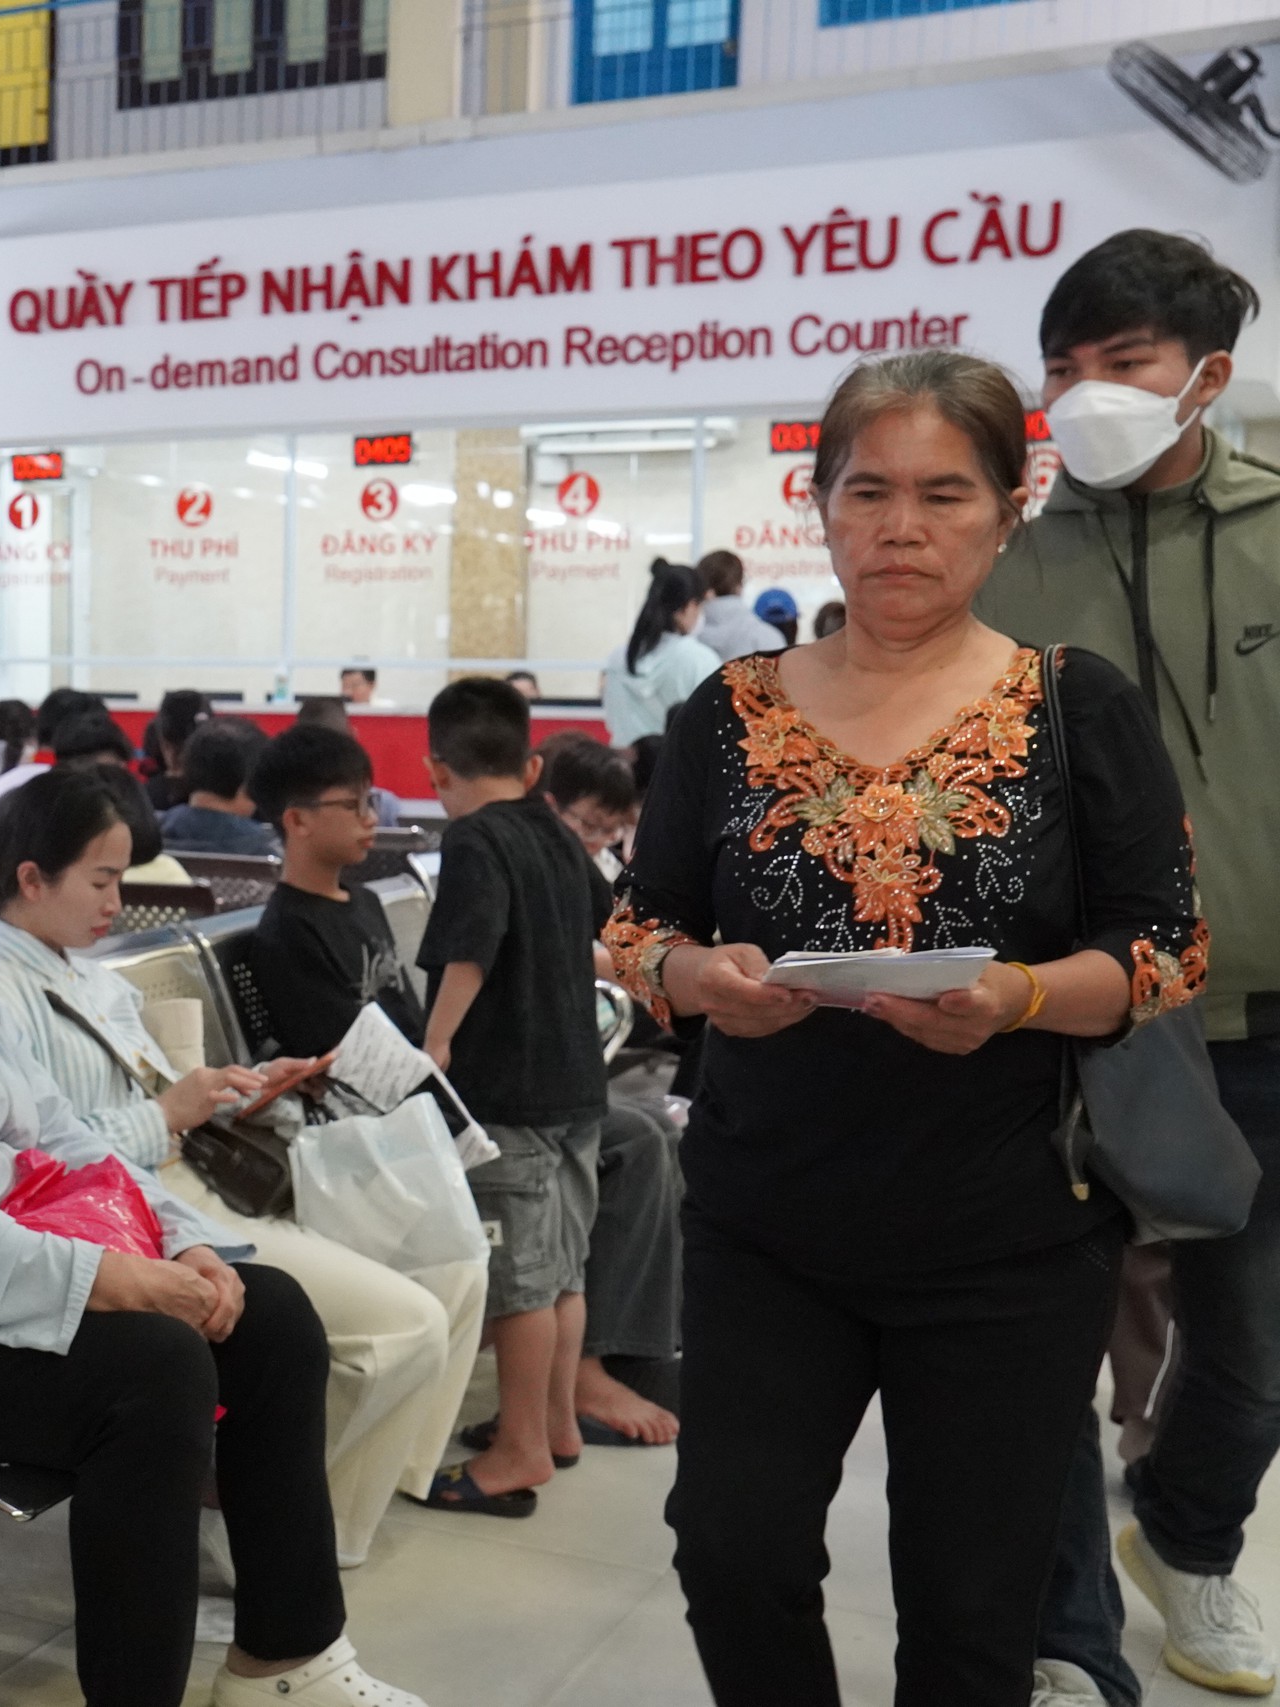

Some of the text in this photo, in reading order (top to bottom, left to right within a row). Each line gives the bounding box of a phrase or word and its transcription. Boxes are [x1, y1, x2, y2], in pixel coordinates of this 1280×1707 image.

[8, 191, 1063, 334] QUẦY TIẾP NHẬN KHÁM THEO YÊU CẦU
[76, 309, 970, 394] On-demand Consultation Reception Counter
[14, 492, 33, 529] 1
[183, 487, 208, 521] 2
[366, 480, 393, 521] 3
[561, 475, 593, 516] 4
[149, 538, 194, 559] THU
[524, 530, 578, 553] THU
